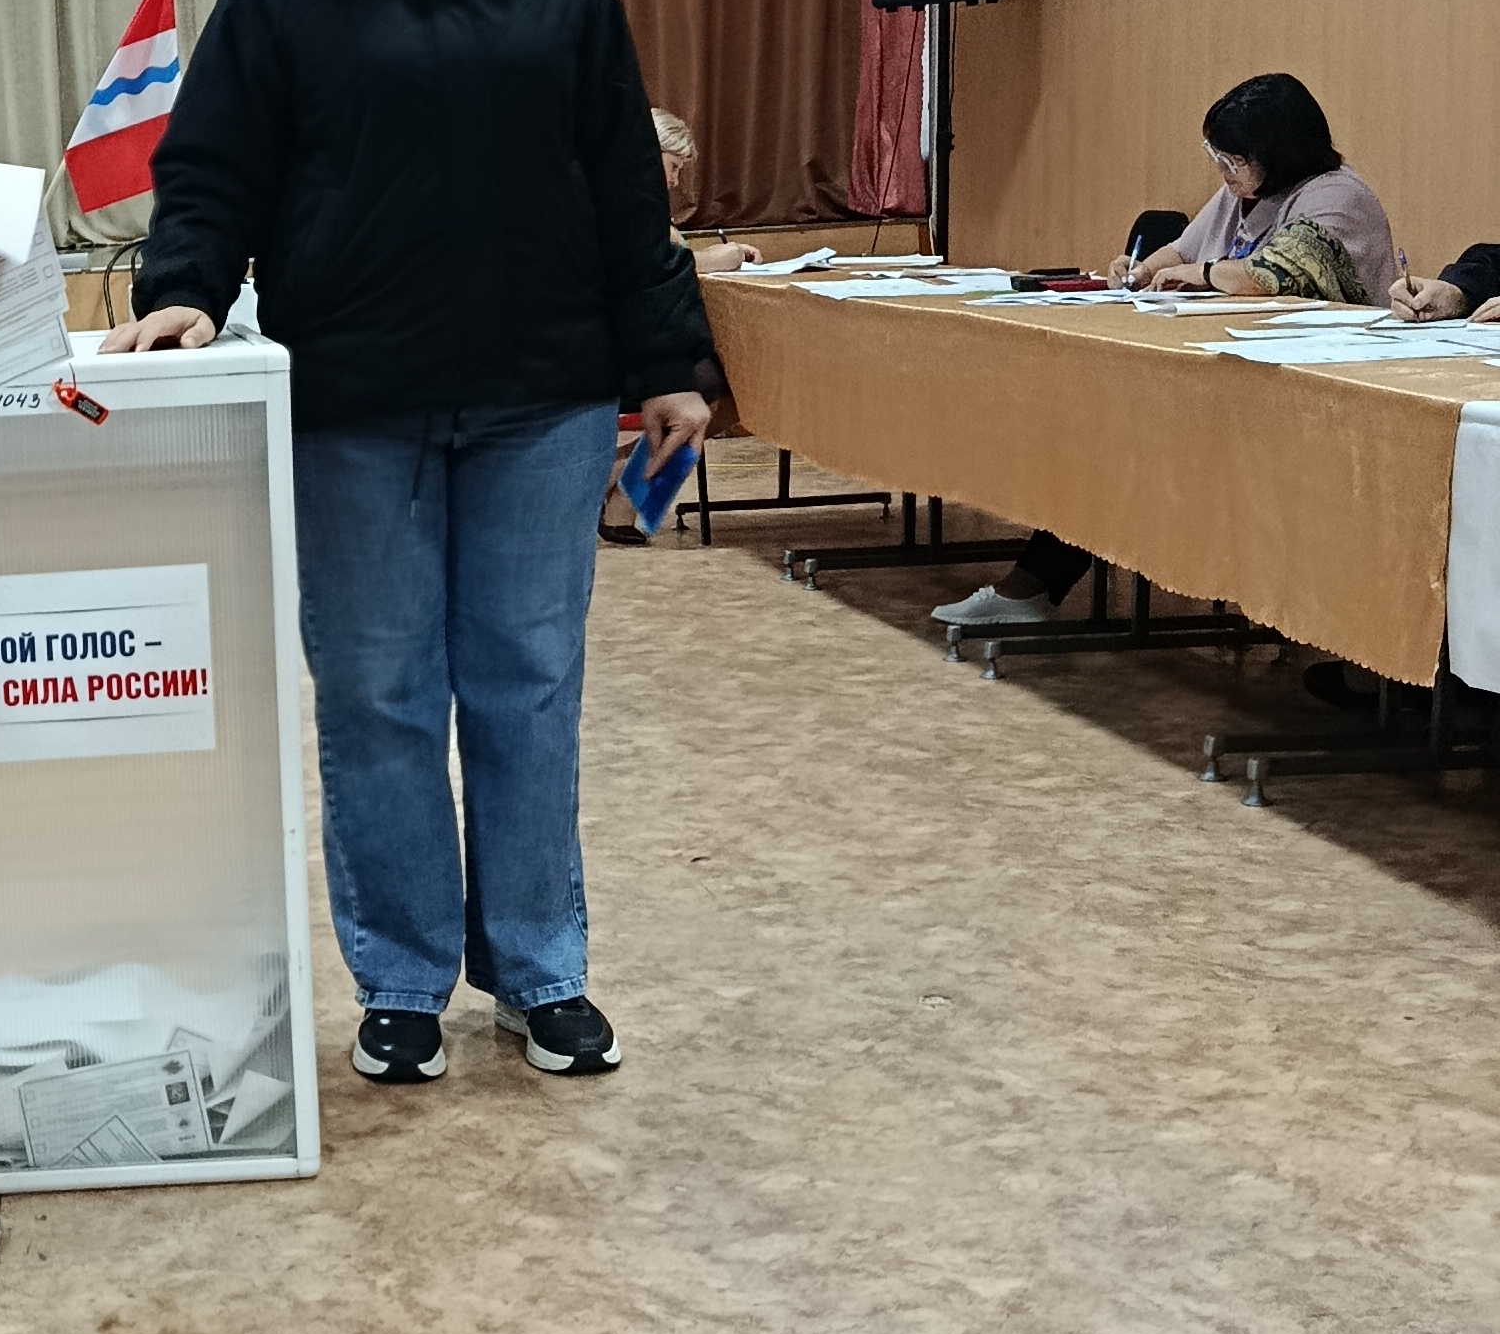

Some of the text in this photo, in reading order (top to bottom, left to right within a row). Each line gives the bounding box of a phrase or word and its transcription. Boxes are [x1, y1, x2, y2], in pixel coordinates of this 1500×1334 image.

[45, 629, 136, 662] ГОЛОС
[2, 668, 209, 707] СИЛА РОССИИ!
